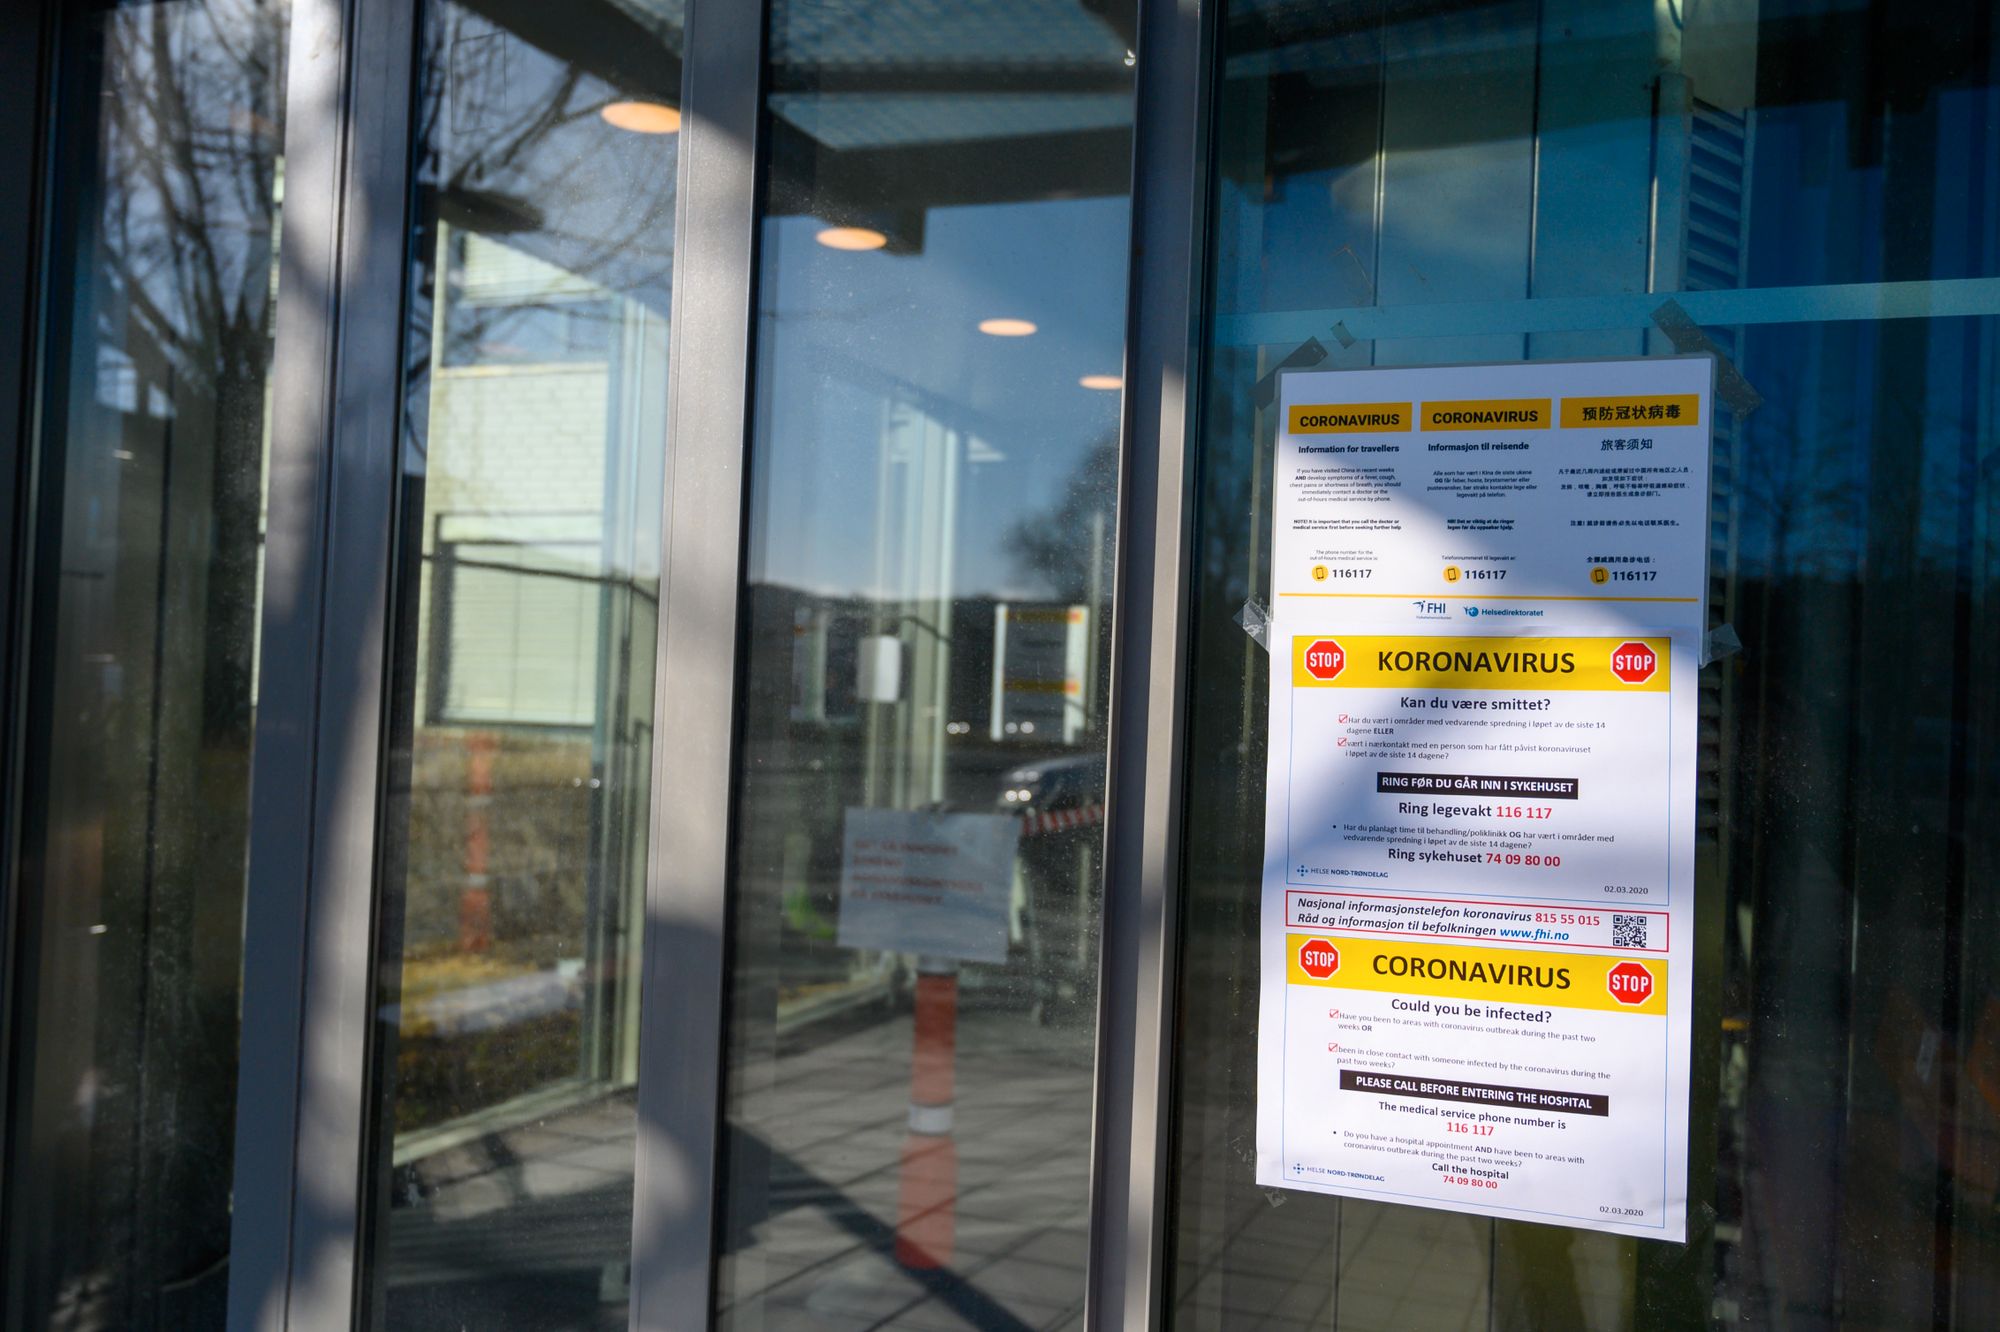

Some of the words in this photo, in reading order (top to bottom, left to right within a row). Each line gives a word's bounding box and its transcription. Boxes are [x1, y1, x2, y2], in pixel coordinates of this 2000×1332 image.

[1432, 410, 1538, 424] CORONAVIRUS
[1582, 404, 1681, 421] 预防冠状病毒
[1300, 413, 1400, 427] CORONAVIRUS
[1298, 445, 1345, 454] Information
[1347, 445, 1359, 453] for
[1361, 445, 1399, 453] travellers
[1428, 442, 1479, 451] Informasjon
[1481, 443, 1489, 451] til
[1491, 442, 1529, 450] reisende
[1601, 438, 1653, 451] 旅客须知
[1332, 569, 1372, 578] 116117
[1465, 570, 1507, 580] 116117
[1612, 571, 1657, 581] 116117
[1427, 603, 1446, 614] FHI
[1481, 608, 1543, 617] Helsedirektoratet
[1310, 652, 1340, 668] STOP
[1378, 651, 1575, 673] KORONAVIRUS
[1616, 655, 1652, 671] STOP
[1401, 697, 1425, 708] Kan
[1430, 697, 1448, 709] du
[1452, 699, 1487, 709] være
[1491, 698, 1550, 710] smittet?
[1394, 717, 1425, 725] områder
[1445, 718, 1488, 727] vedvarende
[1490, 720, 1527, 728] spredning
[1532, 721, 1552, 729] løpet
[1346, 727, 1372, 736] dagene
[1440, 743, 1465, 751] person
[1514, 744, 1536, 754] påvist
[1538, 745, 1591, 753] koronaviruset
[1382, 777, 1408, 787] RING
[1411, 777, 1433, 788] FØR
[1435, 779, 1452, 788] DU
[1454, 776, 1478, 789] GÅR
[1481, 780, 1501, 789] INN
[1510, 781, 1573, 792] SYKEHUSET
[1399, 802, 1429, 816] Ring
[1433, 803, 1491, 818] legevakt
[1496, 806, 1522, 817] 116
[1526, 808, 1552, 819] 117
[1357, 824, 1367, 832] du
[1369, 824, 1397, 834] planlagt
[1417, 826, 1425, 834] til
[1426, 826, 1507, 838] behandling/poliklinikk
[1538, 832, 1556, 840] vært
[1562, 833, 1595, 842] områder
[1388, 849, 1415, 861] Ring
[1418, 850, 1482, 864] sykehuset
[1486, 853, 1501, 864] 74
[1505, 854, 1520, 864] 09
[1525, 855, 1540, 866] 80
[1544, 856, 1560, 866] 00
[1330, 869, 1388, 878] NORD-TRØNDELAG
[1604, 886, 1648, 894] 02.03.2020
[1298, 898, 1345, 910] Nasjonal
[1348, 900, 1460, 917] informasjonstelefon
[1463, 908, 1532, 922] koronavirus
[1535, 912, 1557, 923] 815
[1560, 914, 1574, 924] 55
[1578, 915, 1600, 926] 015
[1298, 913, 1319, 924] Råd
[1321, 916, 1335, 926] og
[1338, 915, 1404, 930] informasjon
[1408, 920, 1419, 930] til
[1422, 920, 1496, 936] befolkningen
[1500, 927, 1569, 941] www.fhi.no
[1305, 951, 1335, 968] STOP
[1372, 954, 1571, 989] CORONAVIRUS
[1612, 974, 1649, 992] STOP
[1392, 999, 1430, 1012] Could
[1434, 1003, 1459, 1017] you
[1464, 1004, 1481, 1017] be
[1486, 1006, 1552, 1023] infected?
[1338, 1023, 1360, 1031] weeks
[1358, 1014, 1371, 1023] you
[1373, 1015, 1391, 1023] been
[1402, 1018, 1422, 1026] areas
[1423, 1019, 1439, 1028] with
[1441, 1021, 1484, 1033] coronavirus
[1486, 1025, 1520, 1036] outbreak
[1521, 1029, 1545, 1039] during
[1547, 1030, 1560, 1039] the
[1562, 1032, 1578, 1042] past
[1580, 1034, 1595, 1042] two
[1356, 1076, 1392, 1089] PLEASE
[1394, 1080, 1418, 1092] CALL
[1420, 1083, 1459, 1096] BEFORE
[1461, 1087, 1514, 1101] ENTERING
[1516, 1093, 1536, 1103] THE
[1539, 1094, 1592, 1109] HOSPITAL
[1379, 1101, 1397, 1111] The
[1399, 1103, 1438, 1116] medical
[1440, 1108, 1476, 1120] service
[1478, 1113, 1511, 1126] phone
[1514, 1116, 1555, 1129] number
[1558, 1119, 1566, 1129] is
[1447, 1122, 1468, 1134] 116
[1472, 1124, 1494, 1136] 117
[1307, 1166, 1325, 1174] HELSE
[1327, 1168, 1385, 1182] NORD-TRØNDELAG
[1432, 1162, 1449, 1172] Call
[1452, 1164, 1468, 1175] the
[1470, 1166, 1509, 1180] hospital
[1443, 1175, 1455, 1184] 74
[1457, 1176, 1469, 1186] 09
[1471, 1178, 1483, 1187] 80
[1485, 1179, 1497, 1189] 00
[1600, 1205, 1644, 1216] 02.03.2020
